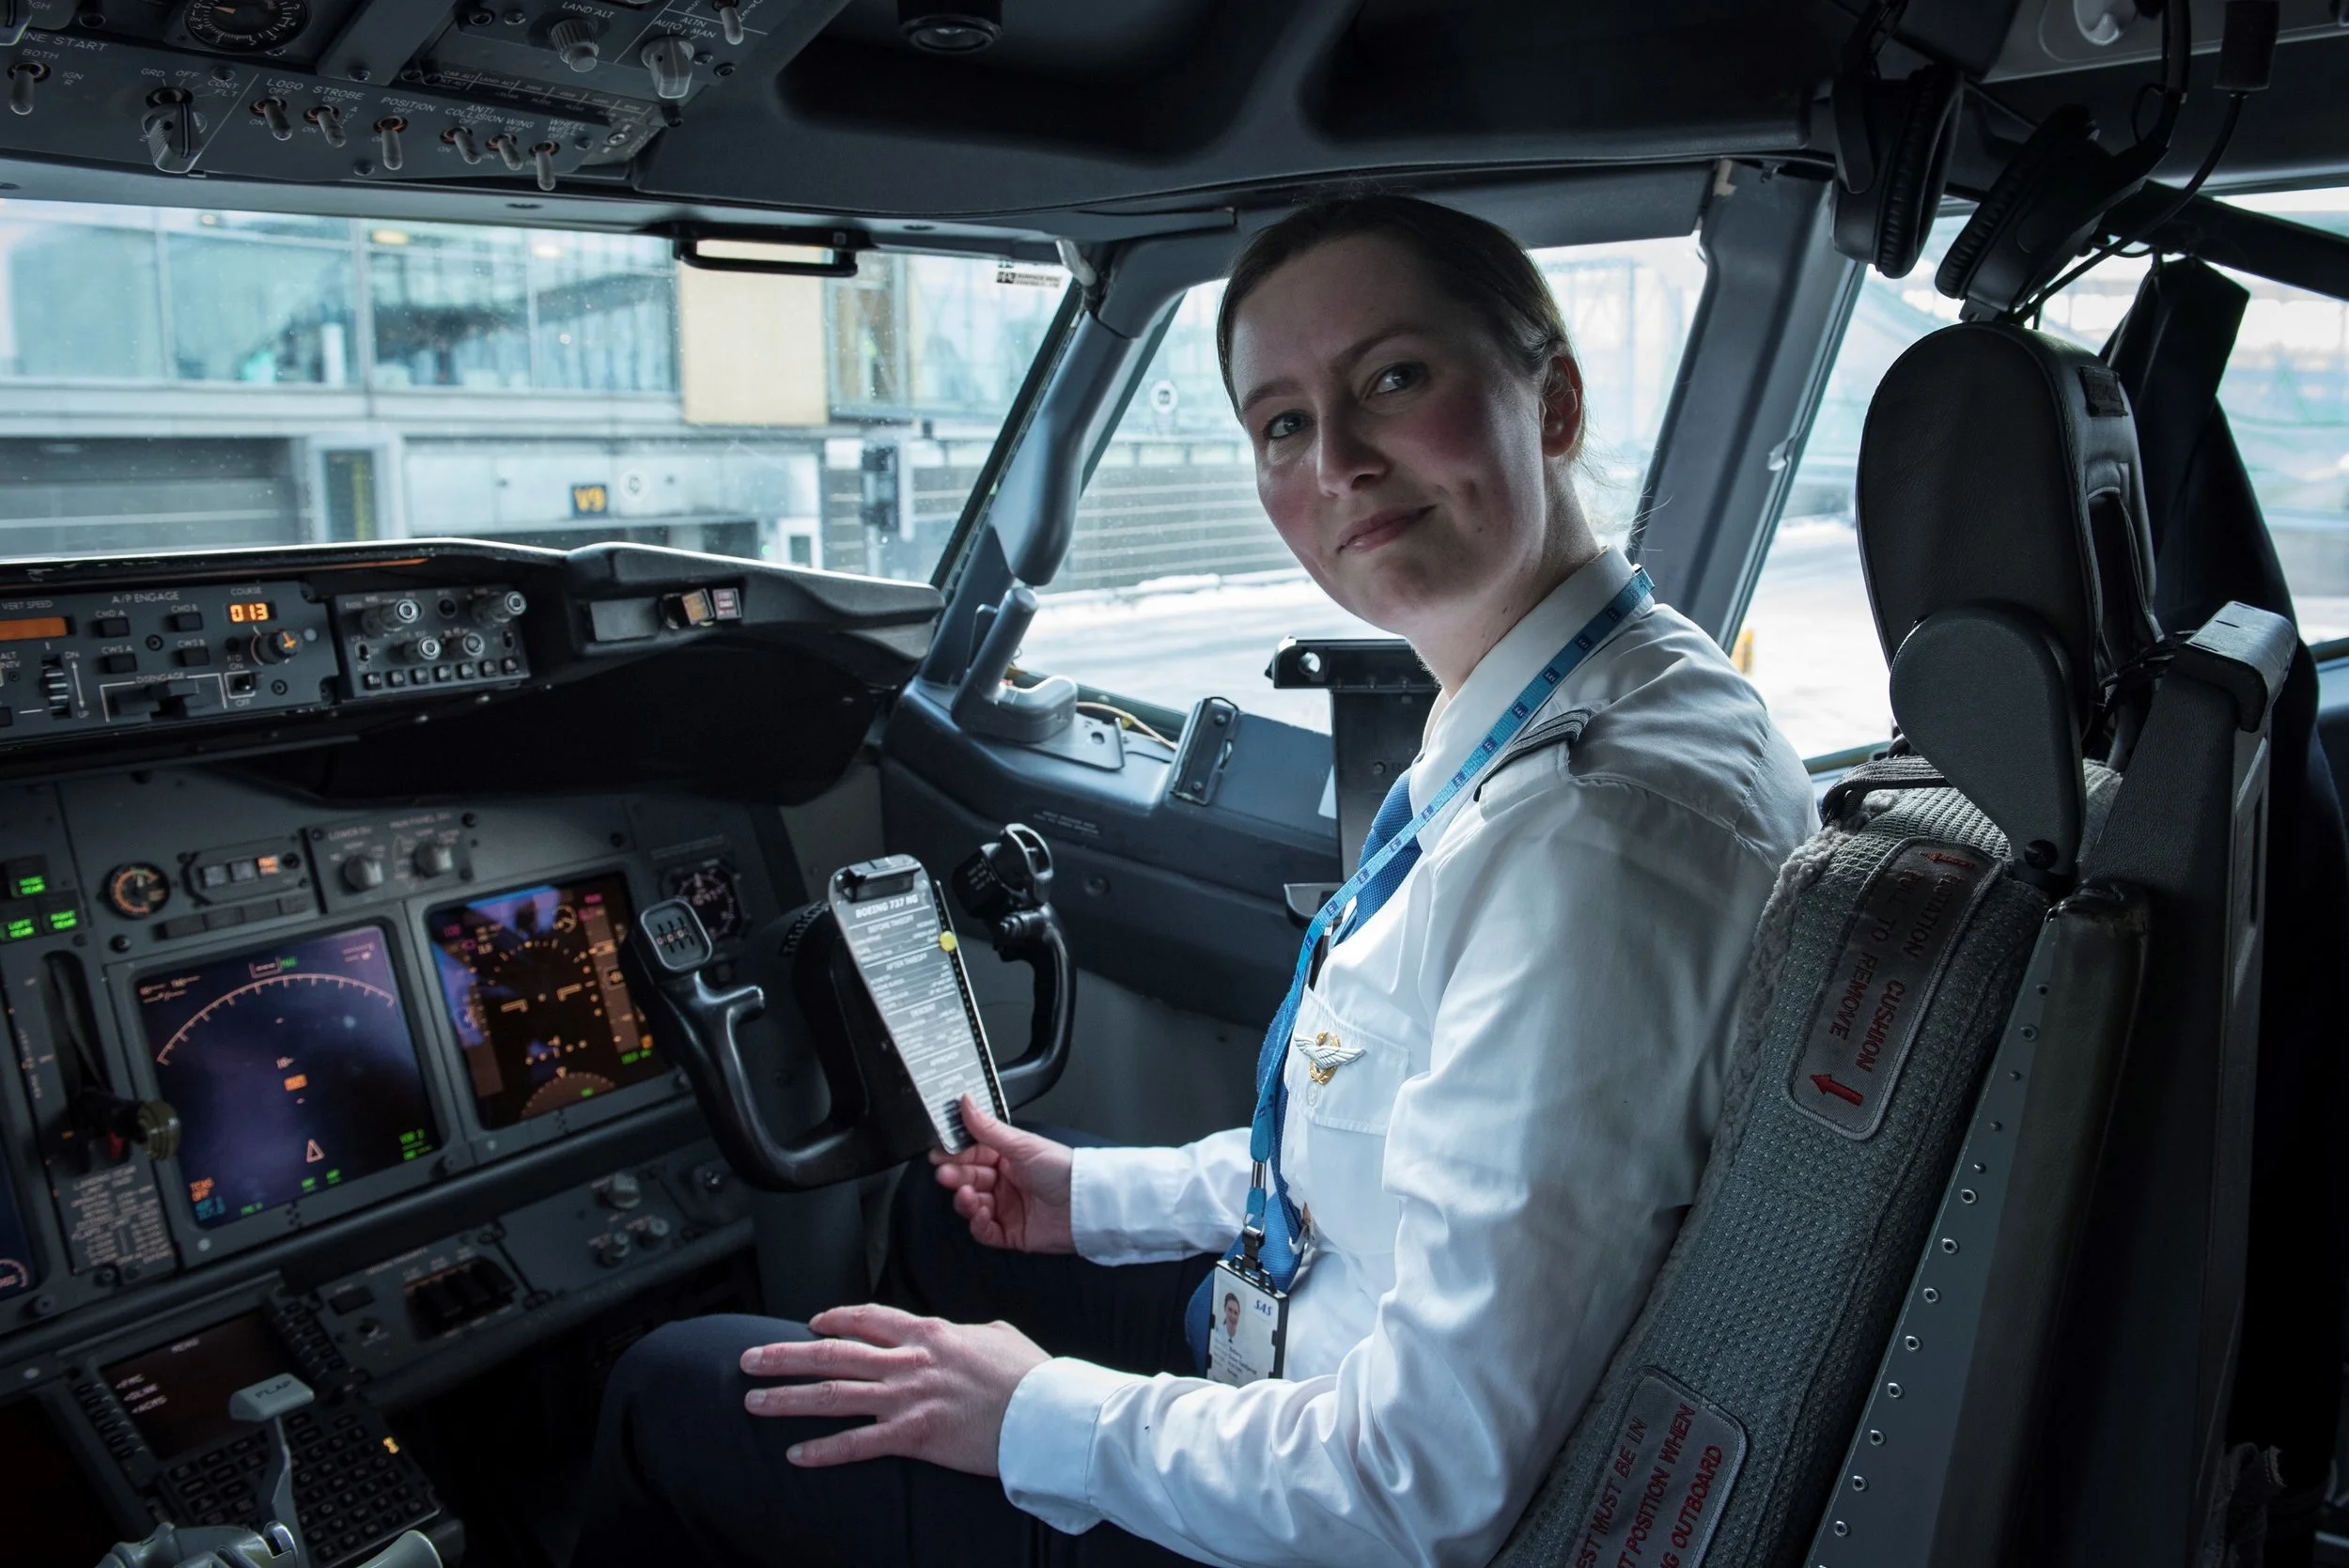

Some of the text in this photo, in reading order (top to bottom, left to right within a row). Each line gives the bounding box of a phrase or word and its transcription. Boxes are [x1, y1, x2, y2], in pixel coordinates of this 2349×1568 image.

[562, 2, 615, 19] LAND ALT
[654, 19, 683, 31] AUTO
[680, 16, 708, 27] ALTN
[690, 28, 718, 39] MAN
[53, 36, 109, 54] START
[22, 48, 60, 61] BOTH
[61, 71, 86, 82] IGN
[141, 68, 166, 78] GRD
[175, 69, 201, 80] OFF
[207, 79, 241, 91] CONT
[266, 78, 305, 92] LOGO
[212, 87, 240, 99] FLT
[269, 86, 292, 97] OFF
[311, 85, 366, 101] STROBE
[322, 95, 346, 105] OFF
[380, 96, 438, 114] POSITION
[393, 106, 414, 116] OFF
[444, 107, 506, 124] COLLISION
[466, 104, 495, 115] ANTI
[249, 117, 266, 128] ON
[459, 117, 479, 127] OFF
[506, 117, 535, 129] WING
[549, 117, 586, 132] WHEEL
[302, 126, 319, 135] ON
[503, 124, 524, 133] OFF
[547, 125, 578, 137] WELL
[547, 132, 568, 141] OFF
[437, 145, 453, 154] ON
[111, 591, 180, 604] A/P ENGAGE
[230, 586, 263, 597] COURSE
[1, 599, 54, 611] VERT SPEED
[229, 602, 270, 624] 013
[135, 672, 186, 684] DISENGAGE
[855, 893, 919, 919] BOEING 737 NG
[1870, 916, 1897, 944] TO
[1828, 951, 1878, 1041] REMOVE
[1856, 979, 1906, 1073] CUSHION
[1254, 1299, 1273, 1316] SAS
[255, 1380, 293, 1399] FLAP
[1589, 1476, 1623, 1535] MUST
[1613, 1444, 1638, 1479] BE
[1626, 1416, 1648, 1445] IN
[1625, 1465, 1672, 1555] POSITION
[1657, 1403, 1696, 1466] WHEN
[1671, 1445, 1723, 1549] OUTBOARD
